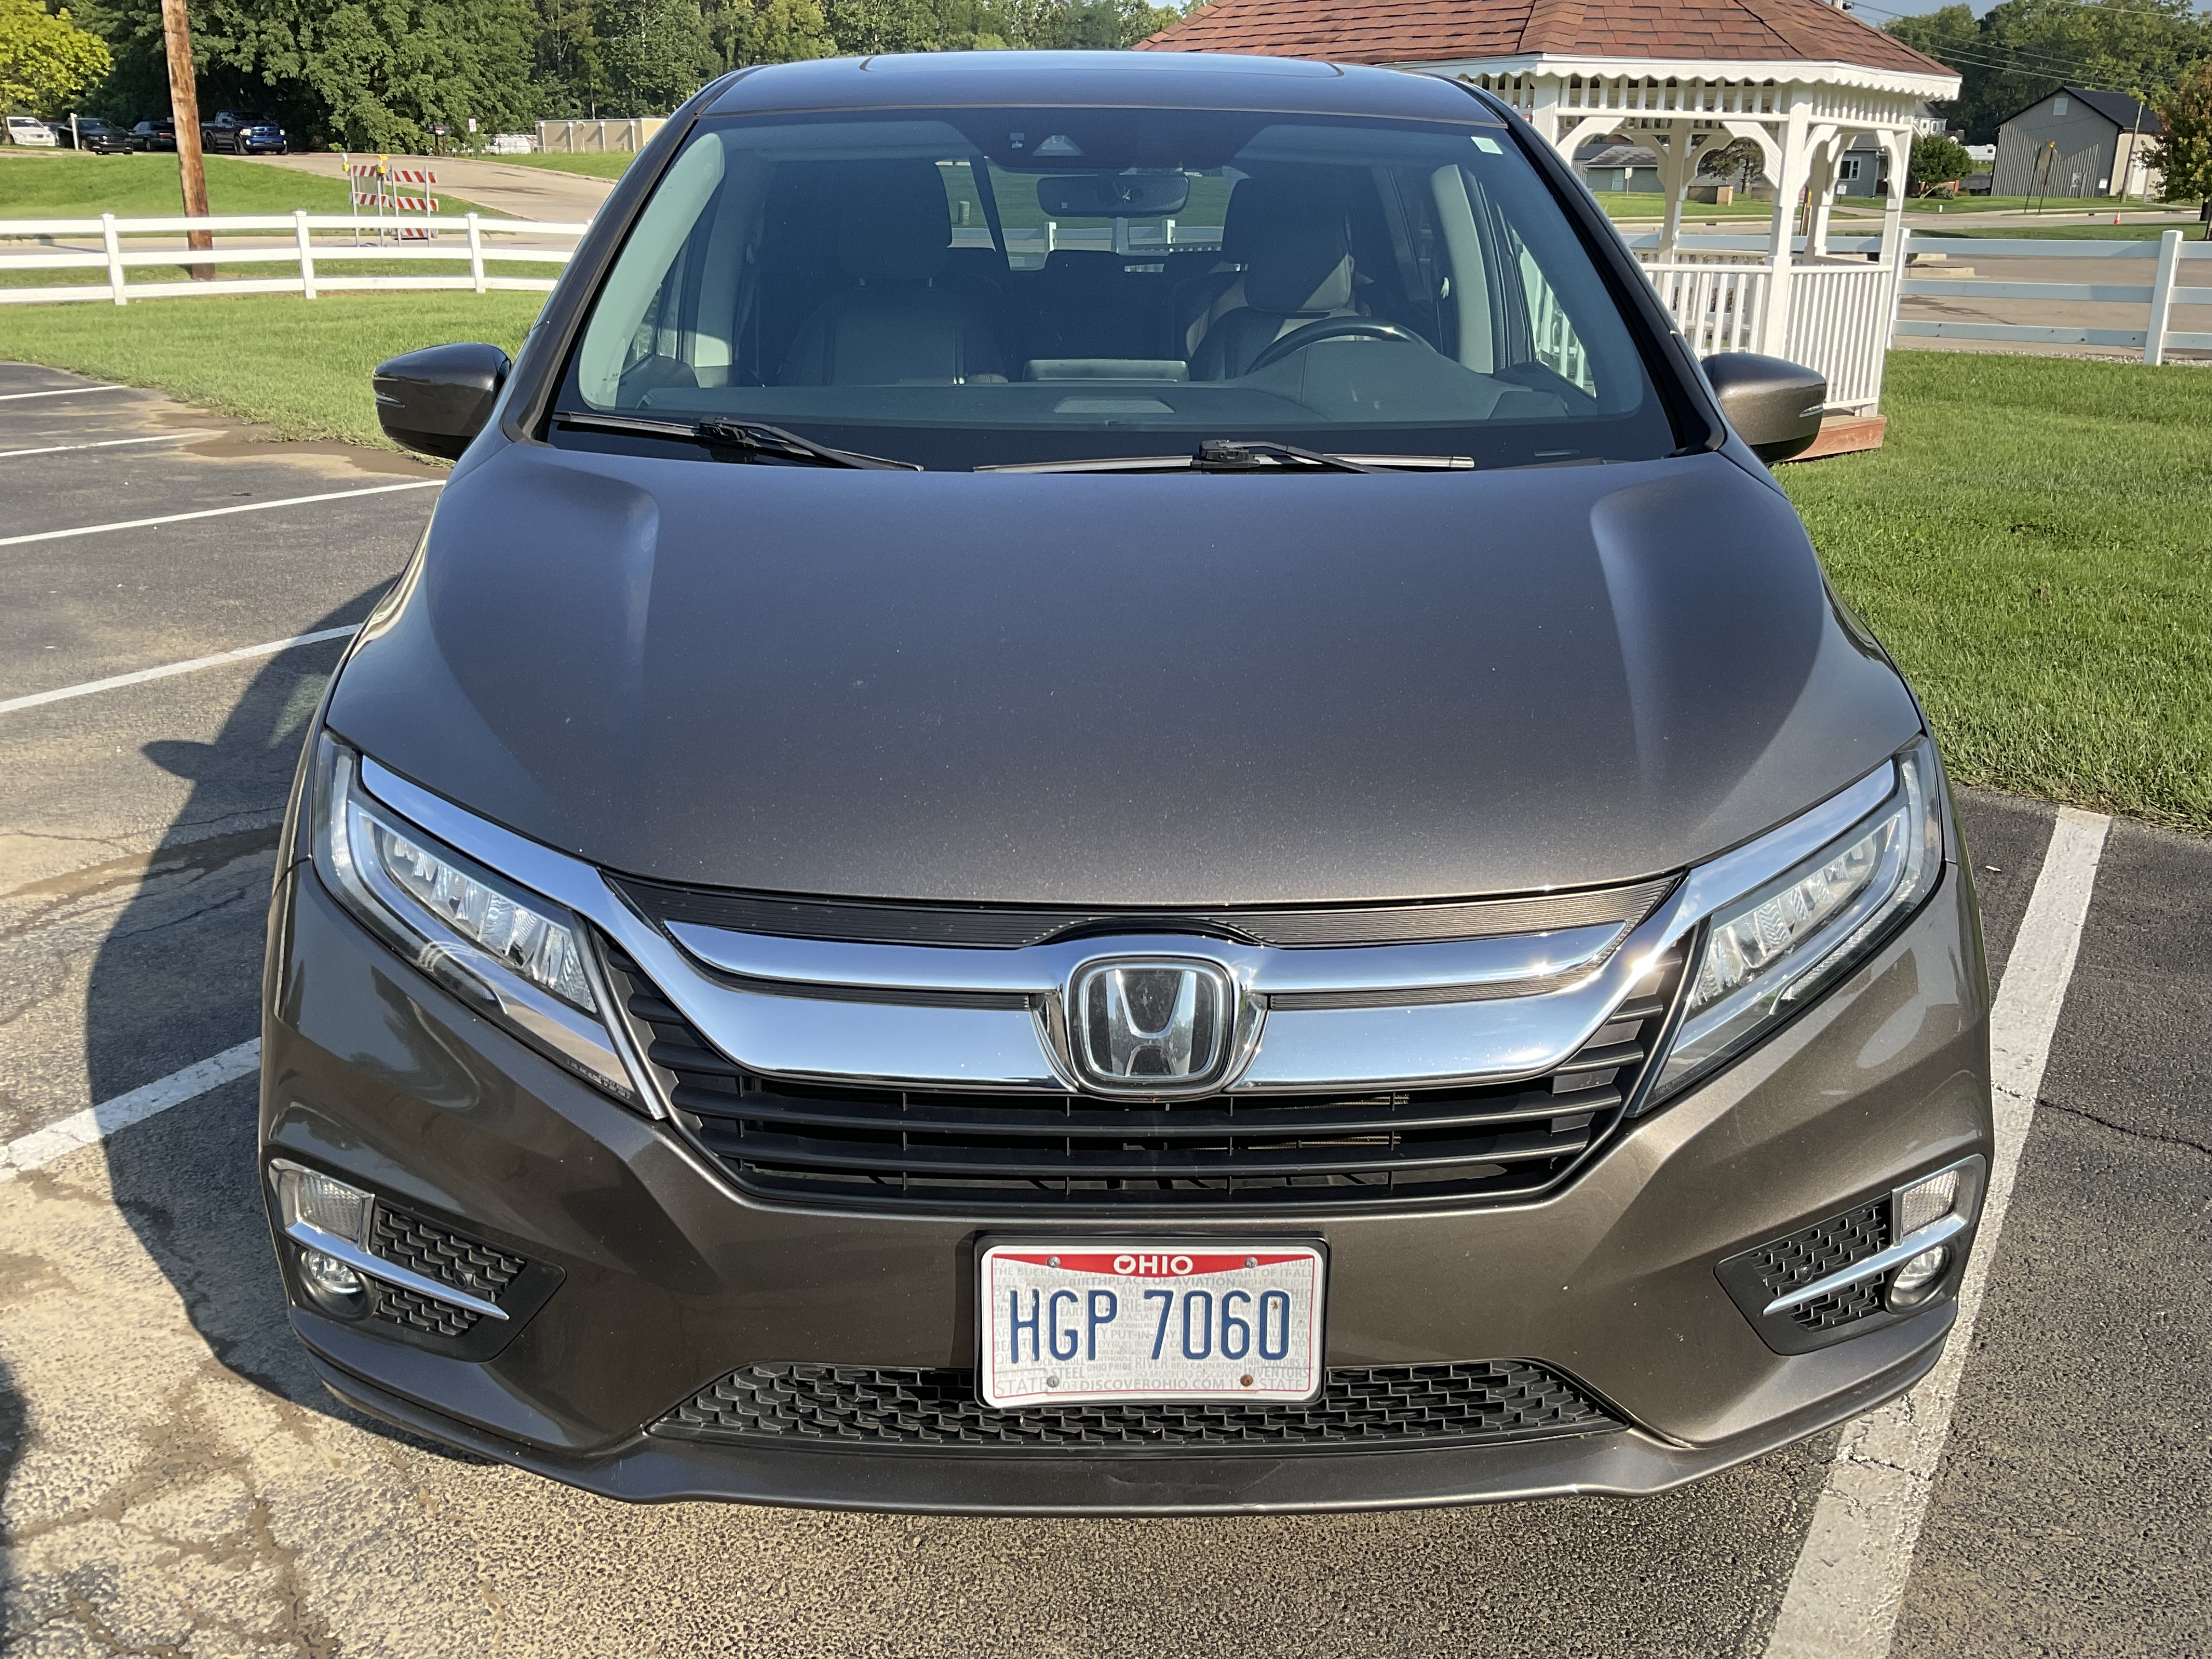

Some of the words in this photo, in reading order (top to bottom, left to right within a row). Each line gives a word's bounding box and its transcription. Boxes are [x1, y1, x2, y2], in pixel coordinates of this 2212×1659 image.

[1114, 1255, 1193, 1274] OHIO
[1017, 1268, 1069, 1277] BUCKEYE
[1262, 1268, 1277, 1278] OF
[1069, 1277, 1149, 1286] BIRTHPLACE
[1152, 1277, 1169, 1285] OF
[1173, 1277, 1235, 1286] AVIATION
[1010, 1289, 1118, 1363] HGP
[1143, 1289, 1290, 1361] 7060
[1052, 1367, 1085, 1379] STEEL
[995, 1377, 1049, 1396] STATE
[1080, 1379, 1224, 1390] DISCOVEROHIO.COM
[1260, 1379, 1302, 1390] STATE
